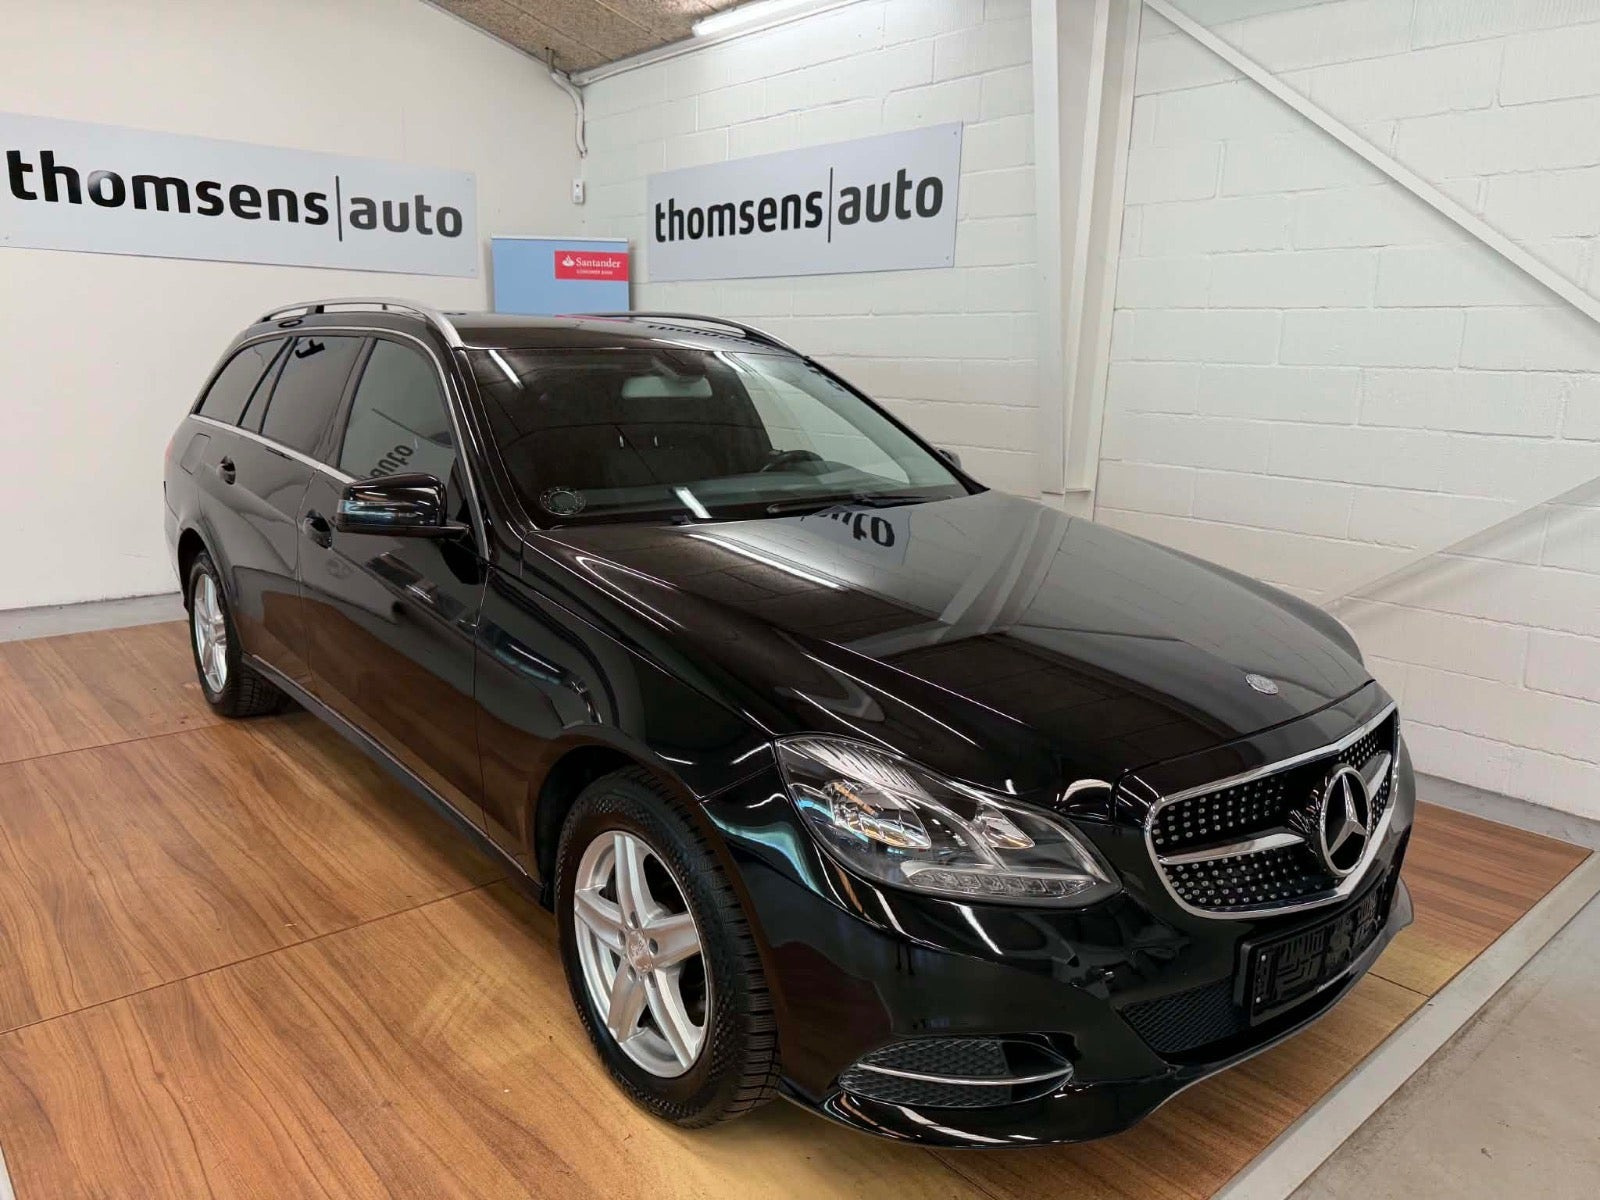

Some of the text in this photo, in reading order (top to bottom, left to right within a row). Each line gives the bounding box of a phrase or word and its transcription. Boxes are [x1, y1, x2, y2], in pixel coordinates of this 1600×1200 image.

[6, 150, 463, 238] thomsens auto
[655, 168, 944, 243] thomsens auto
[575, 257, 621, 268] Santander
